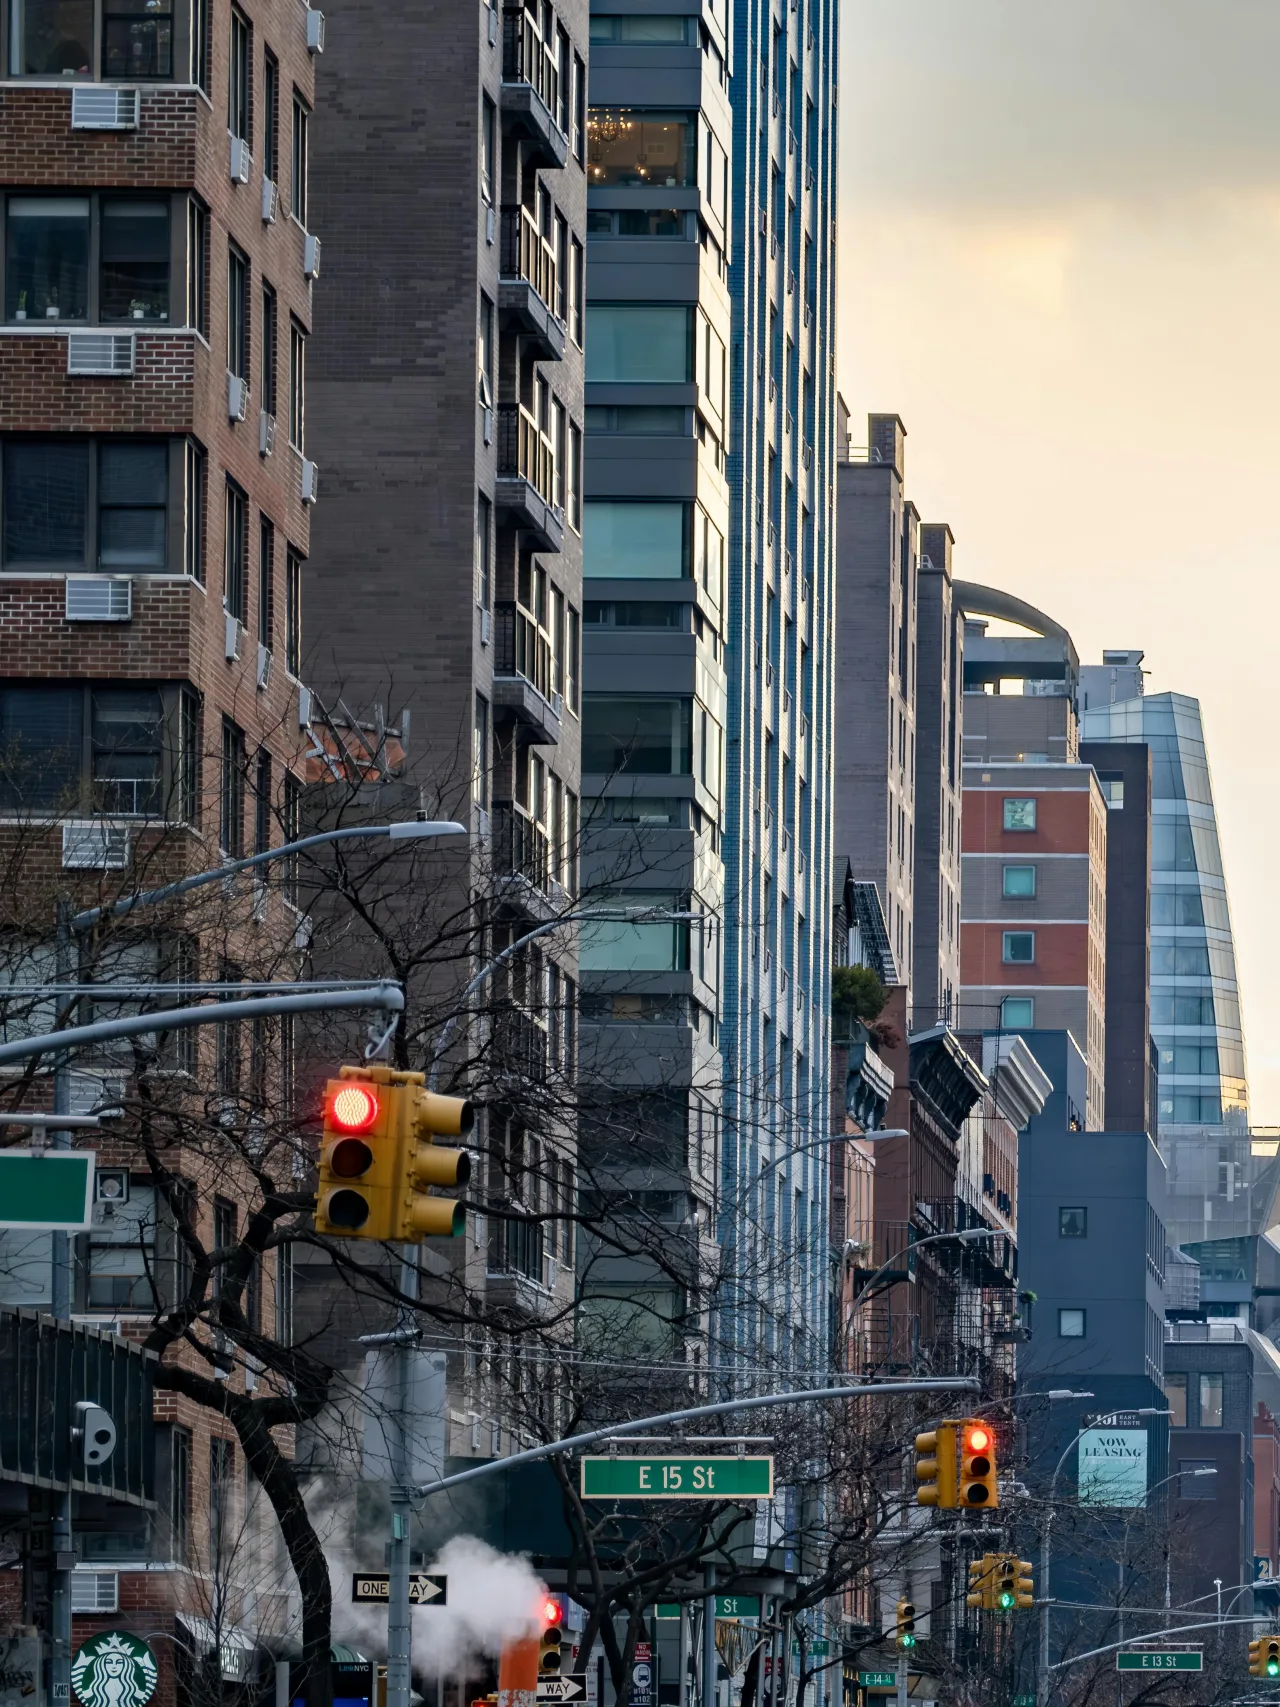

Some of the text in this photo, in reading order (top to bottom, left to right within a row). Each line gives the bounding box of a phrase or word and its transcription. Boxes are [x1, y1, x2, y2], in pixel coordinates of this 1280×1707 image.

[1098, 1437, 1128, 1447] NOW
[1085, 1447, 1141, 1457] LEASING
[639, 1466, 715, 1490] E 15 St
[1258, 1560, 1269, 1578] 2
[362, 1582, 428, 1596] ONE AY
[723, 1598, 738, 1614] St
[1142, 1655, 1177, 1667] E 13 St
[865, 1674, 870, 1685] E
[874, 1674, 882, 1685] 14
[545, 1683, 570, 1695] WAY
